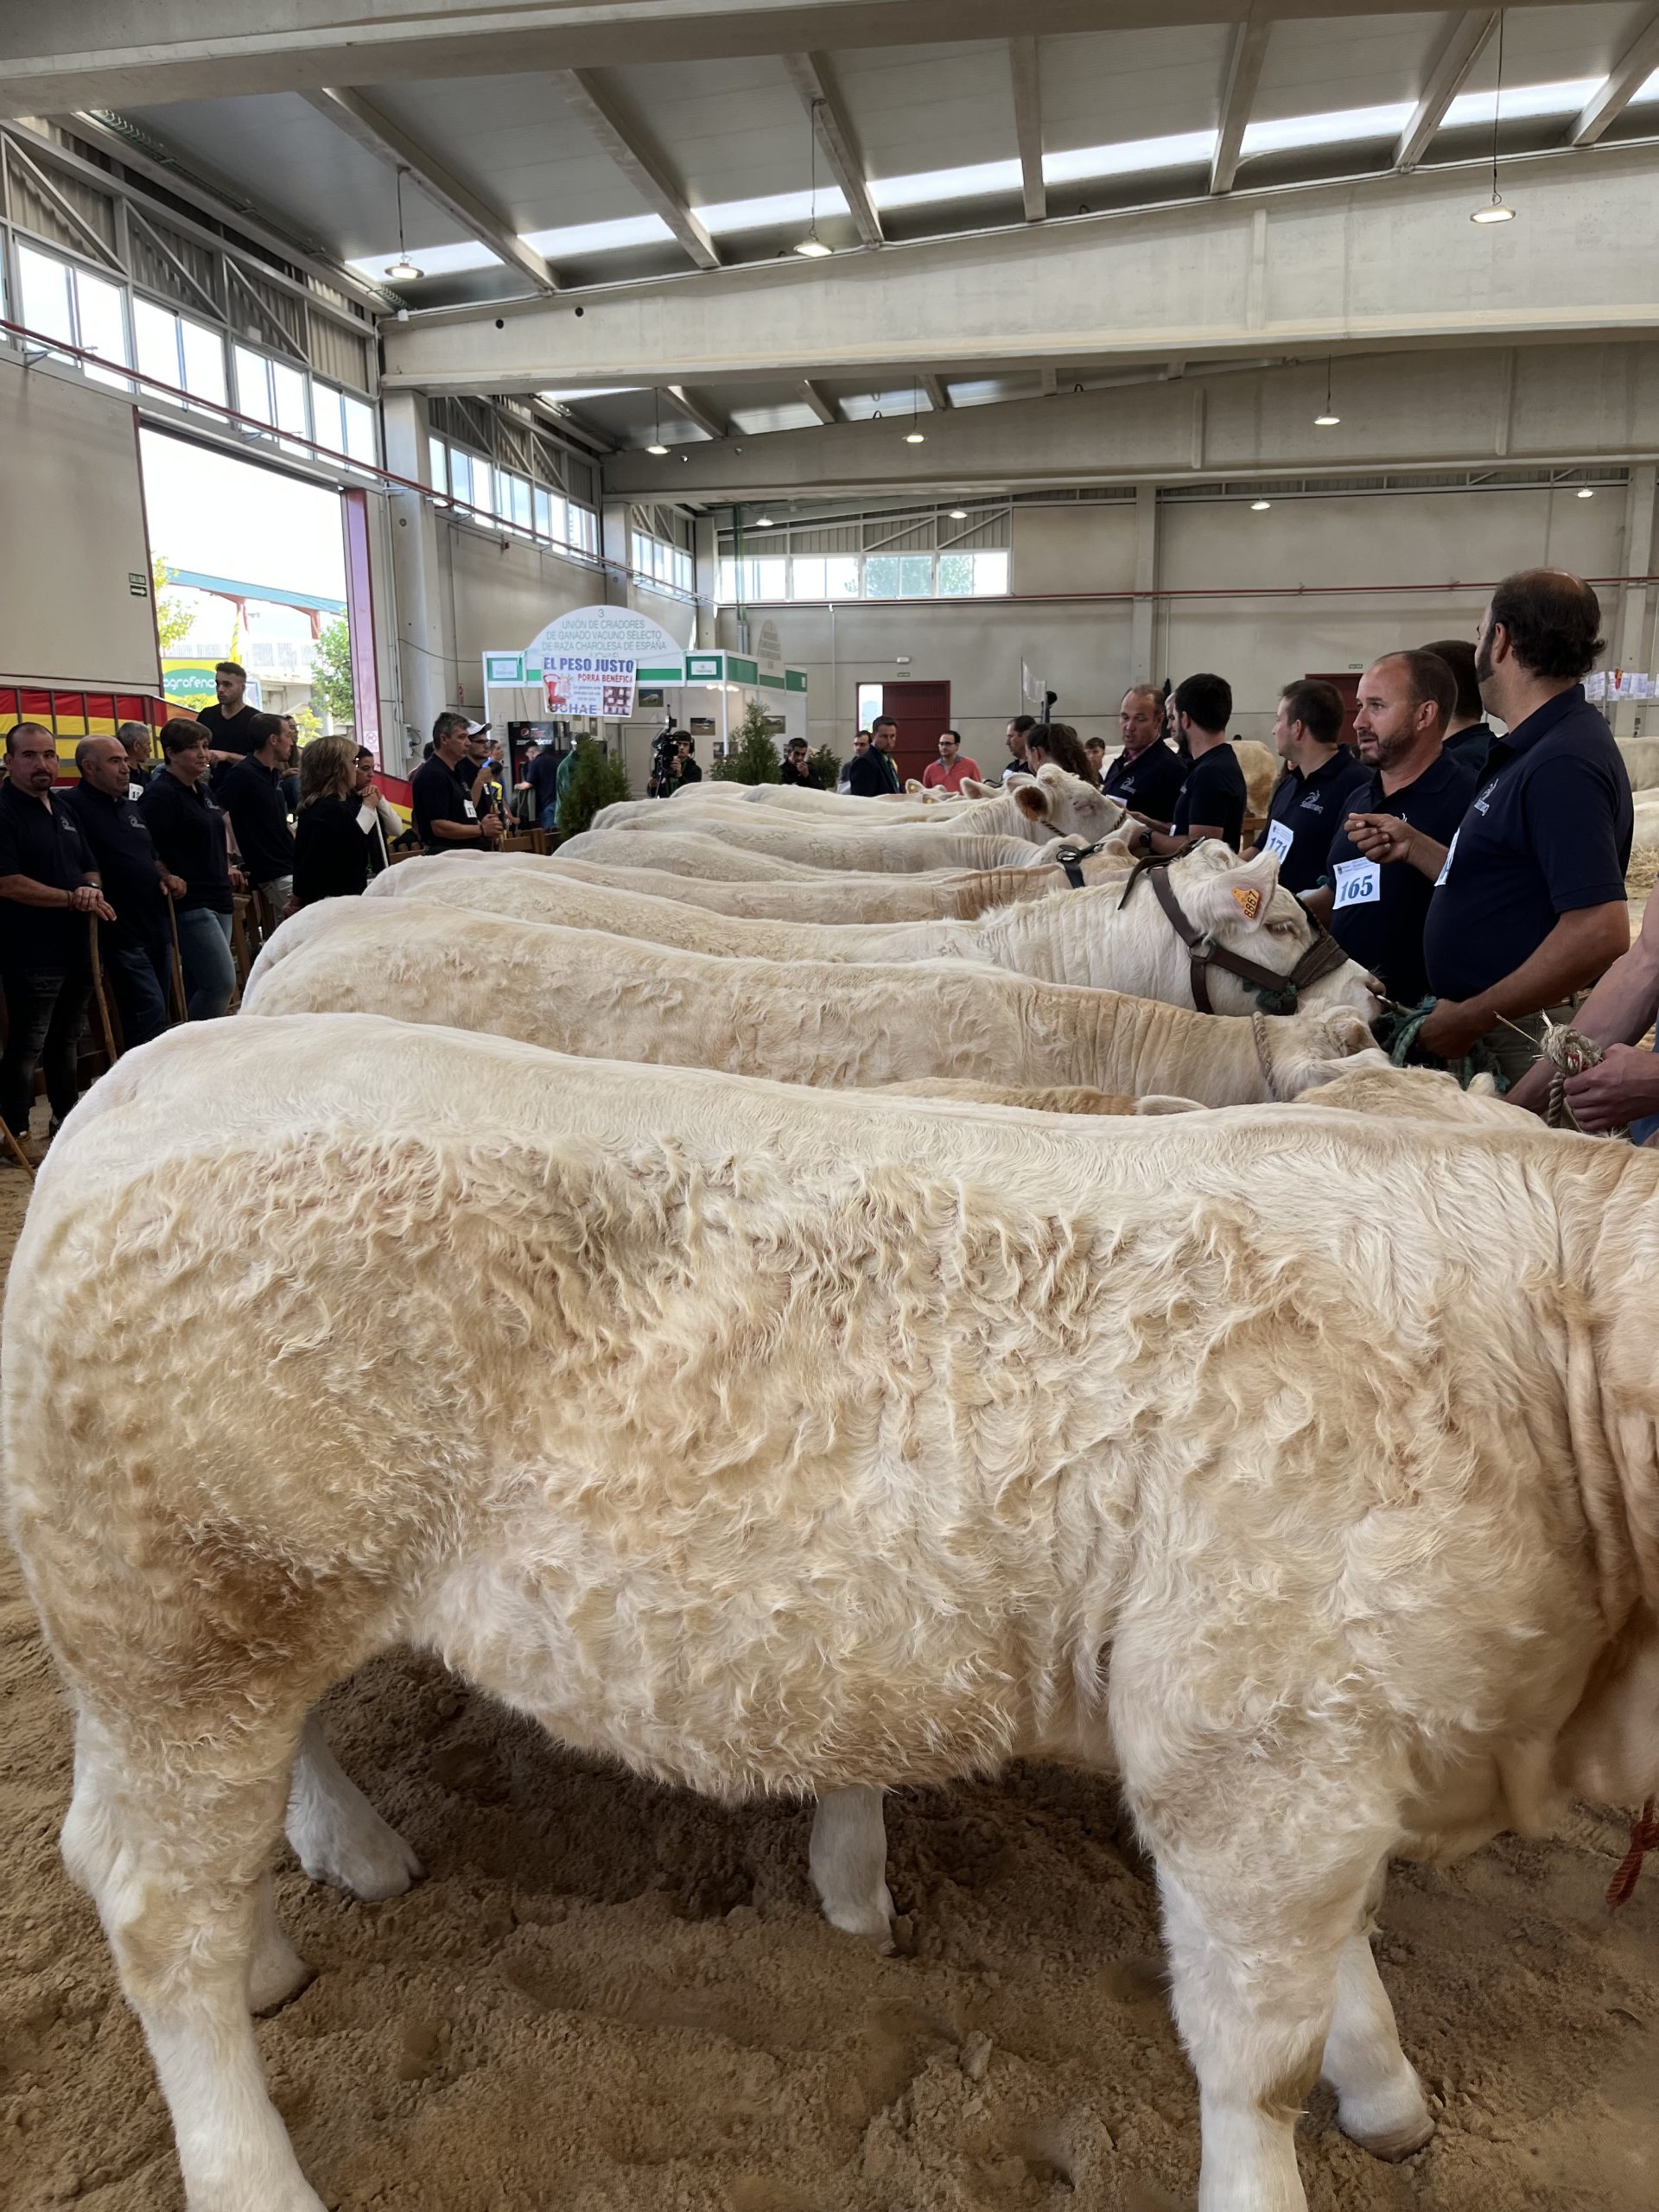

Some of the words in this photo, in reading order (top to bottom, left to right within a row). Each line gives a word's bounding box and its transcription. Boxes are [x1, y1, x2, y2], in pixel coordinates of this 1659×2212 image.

[598, 609, 605, 618] 3
[562, 619, 587, 629] UNIÓN
[601, 620, 645, 629] CRIADORES
[546, 631, 557, 640] DE
[558, 631, 590, 640] GANADO
[592, 631, 626, 640] VACUNO
[626, 630, 662, 639] SELECTO
[542, 642, 553, 651] DE
[554, 642, 575, 651] RAZA
[575, 641, 622, 651] CHAROLESA
[625, 641, 634, 651] DE
[636, 639, 666, 651] ESPAÑA
[543, 657, 557, 671] EL
[560, 658, 592, 671] PESO
[594, 658, 634, 673] JUSTO
[577, 673, 600, 682] PORRA
[1268, 836, 1287, 861] 171
[1340, 874, 1373, 903] 165
[1243, 890, 1258, 918] 8867
